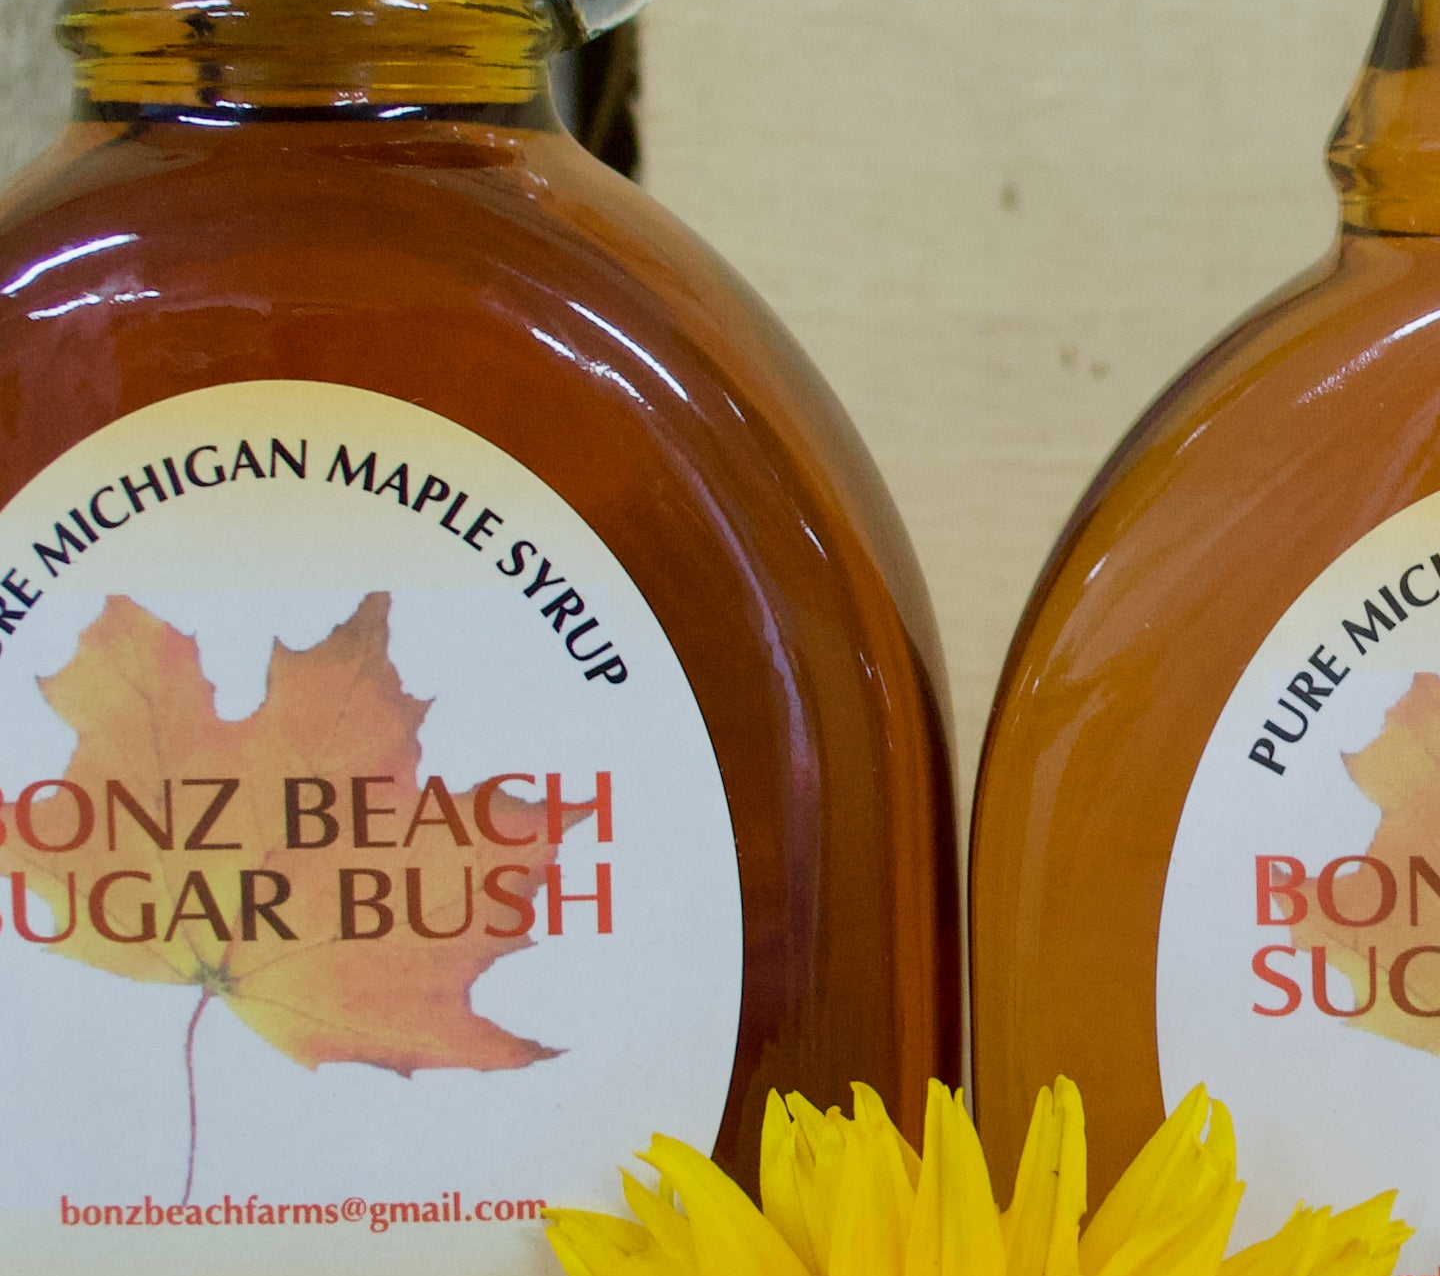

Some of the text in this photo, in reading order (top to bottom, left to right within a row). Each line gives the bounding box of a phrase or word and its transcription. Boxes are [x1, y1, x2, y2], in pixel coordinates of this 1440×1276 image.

[33, 437, 308, 579] MICHIGAN
[326, 443, 505, 554] MAPLE
[496, 539, 630, 690] SYRUP
[1248, 643, 1351, 778] PURE
[283, 771, 615, 850] BEACH
[338, 862, 615, 940] BUSH
[60, 1192, 548, 1233] bonzbeachfarms@gmail.com
